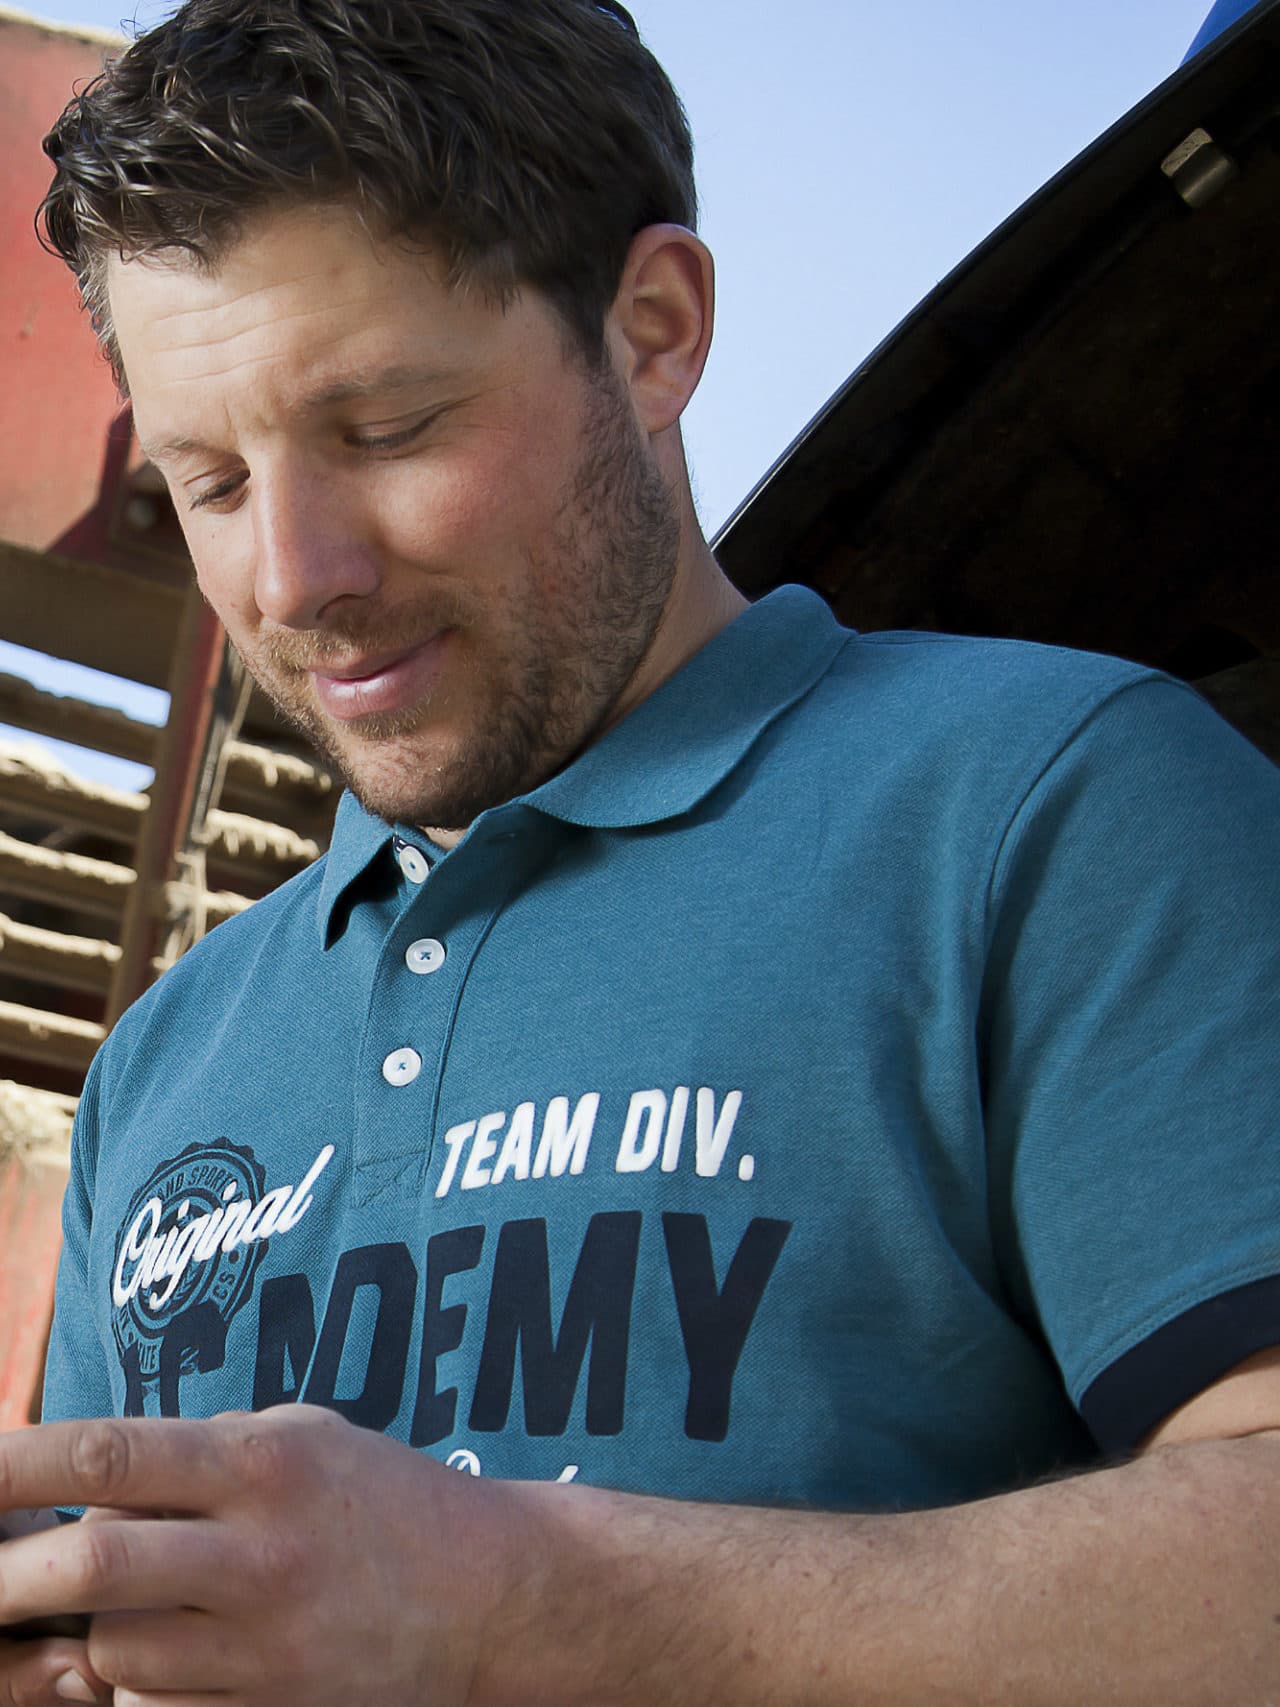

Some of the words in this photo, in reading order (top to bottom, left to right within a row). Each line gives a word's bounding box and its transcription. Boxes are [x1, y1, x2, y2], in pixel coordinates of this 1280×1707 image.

[434, 1092, 601, 1199] TEAM
[615, 1085, 755, 1181] DIV.
[113, 1143, 335, 1311] Original
